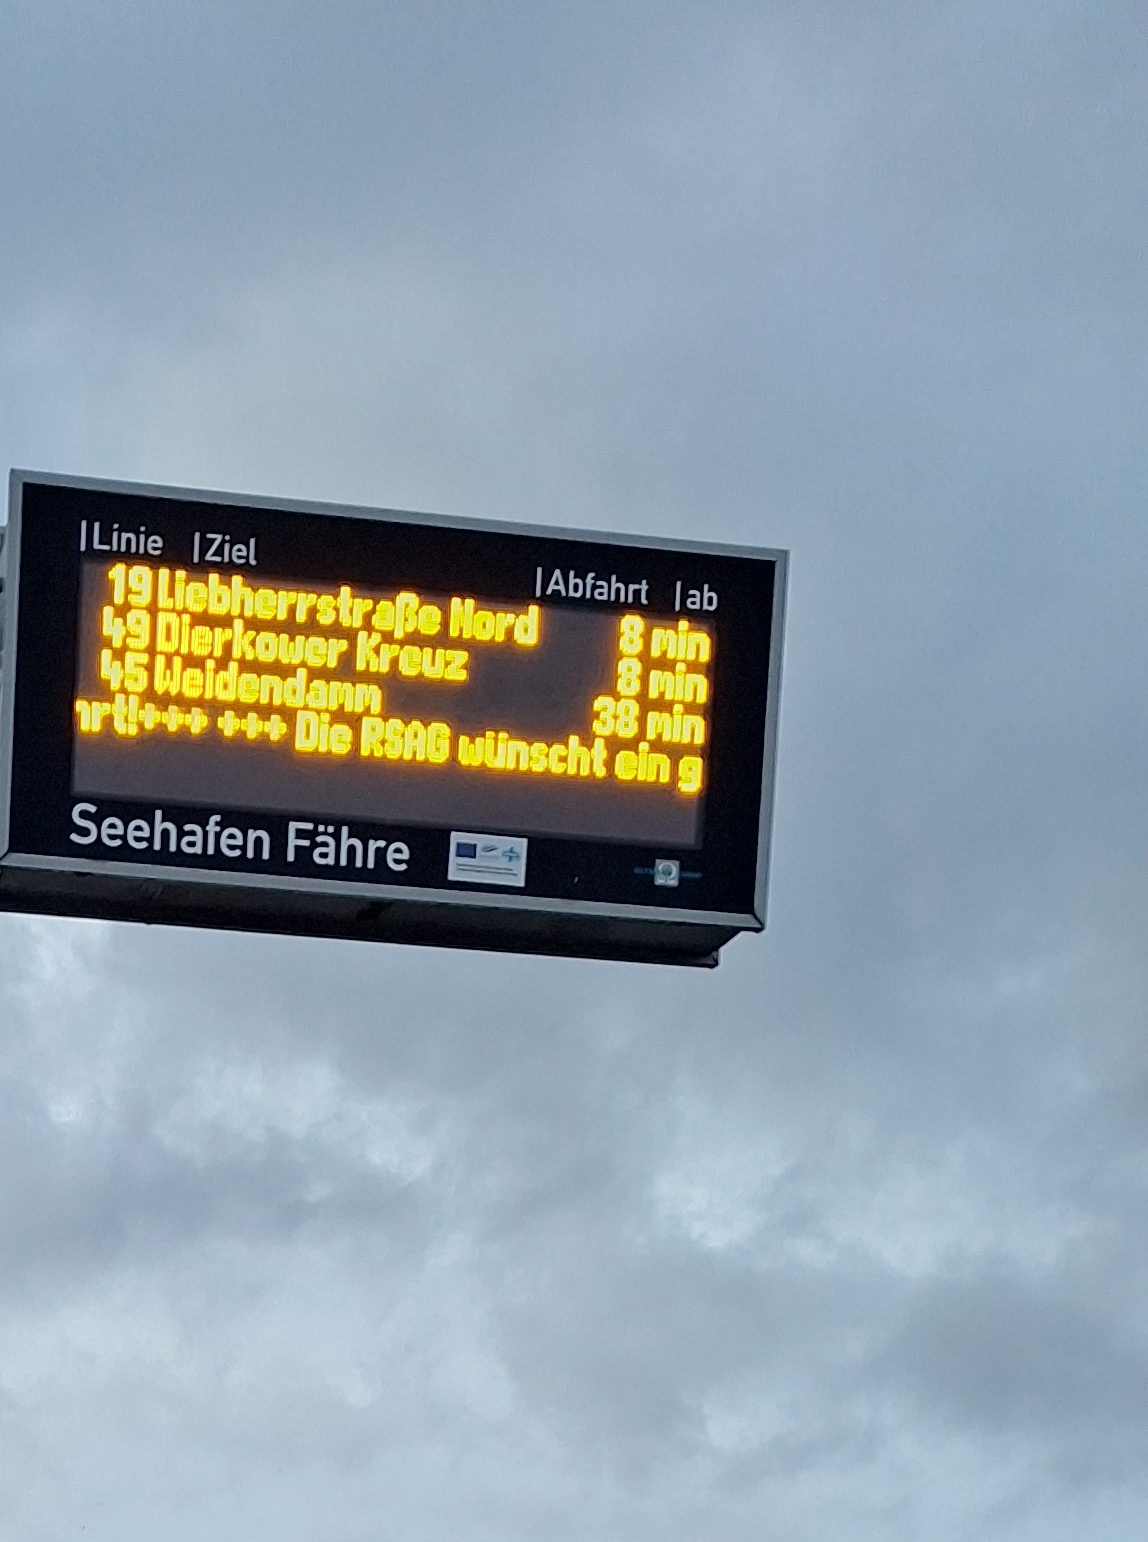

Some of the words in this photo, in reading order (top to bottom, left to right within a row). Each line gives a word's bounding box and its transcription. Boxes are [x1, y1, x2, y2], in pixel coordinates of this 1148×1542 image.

[93, 521, 164, 556] Linie
[204, 533, 257, 566] Ziel
[546, 568, 649, 605] Abfahrt
[686, 583, 718, 611] ab
[108, 562, 152, 607] 19
[158, 567, 442, 639] Liebherrstraße
[449, 596, 540, 646] Nord
[619, 614, 645, 656] 8
[651, 619, 711, 663] min
[100, 648, 150, 693] 45
[153, 653, 382, 714] Weidendamm
[592, 695, 640, 738] 38
[646, 703, 706, 745] min
[102, 605, 151, 650] 49
[156, 611, 348, 668] Dierkower
[356, 630, 469, 681] Kreuz
[617, 656, 642, 697] 8
[648, 662, 708, 704] min
[295, 709, 353, 755] Die
[360, 716, 452, 764] RSAG
[458, 730, 607, 778] wünscht
[614, 741, 671, 784] ein
[677, 756, 704, 793] g
[69, 802, 271, 860] Seehafen
[287, 820, 411, 872] Fähre
